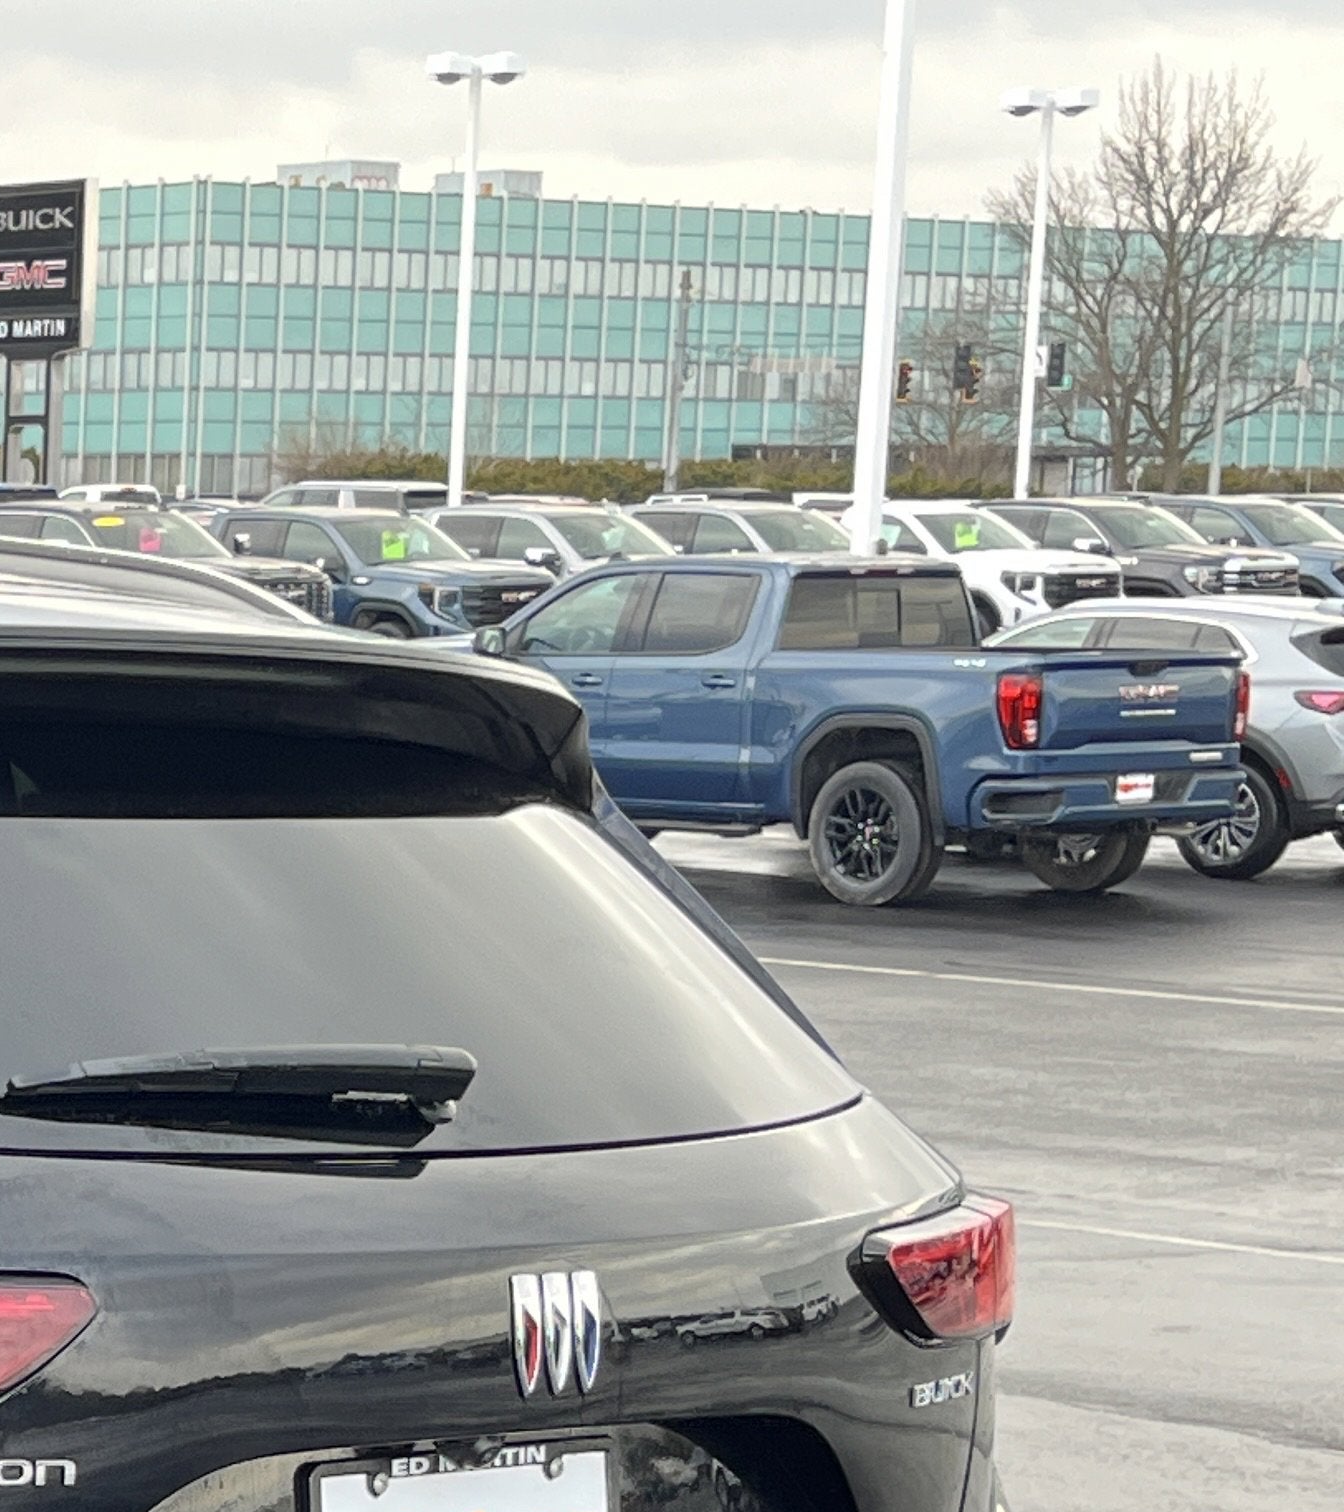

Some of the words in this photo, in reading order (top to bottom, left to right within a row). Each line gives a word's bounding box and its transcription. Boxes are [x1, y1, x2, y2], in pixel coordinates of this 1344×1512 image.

[12, 319, 65, 338] MARTIN
[912, 1370, 974, 1408] BUICK
[391, 1456, 430, 1476] ED
[438, 1444, 547, 1473] MTIN
